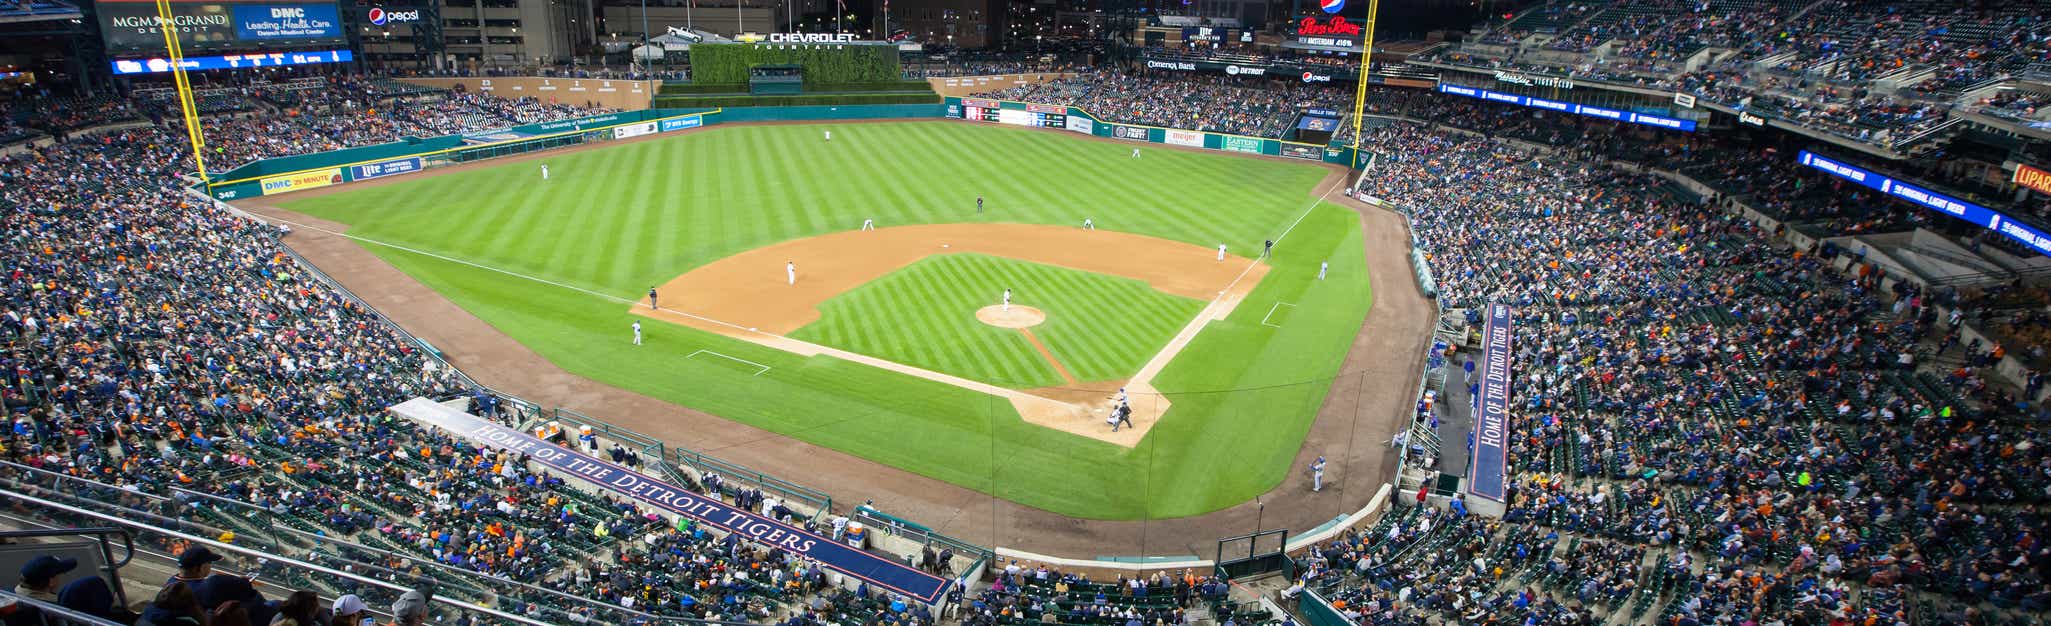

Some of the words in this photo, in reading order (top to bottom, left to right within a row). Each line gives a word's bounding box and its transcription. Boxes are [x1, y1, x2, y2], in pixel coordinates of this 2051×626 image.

[113, 17, 153, 27] MGM
[175, 15, 225, 26] GRAND
[271, 8, 305, 18] DMC
[387, 10, 419, 23] pepsi
[770, 33, 854, 43] CHEVROLET
[265, 180, 291, 190] DMC
[2018, 168, 2051, 193] LIPAR
[1490, 326, 1508, 348] TIGERS
[1488, 348, 1505, 382] DETROIT
[1487, 383, 1504, 400] THE
[1487, 400, 1502, 415] OF
[1481, 415, 1502, 448] HOME
[471, 423, 537, 454] HOME
[535, 448, 562, 466] OF
[566, 457, 610, 480] THE
[612, 473, 720, 518] DETROIT
[724, 512, 817, 554] TIGERS
